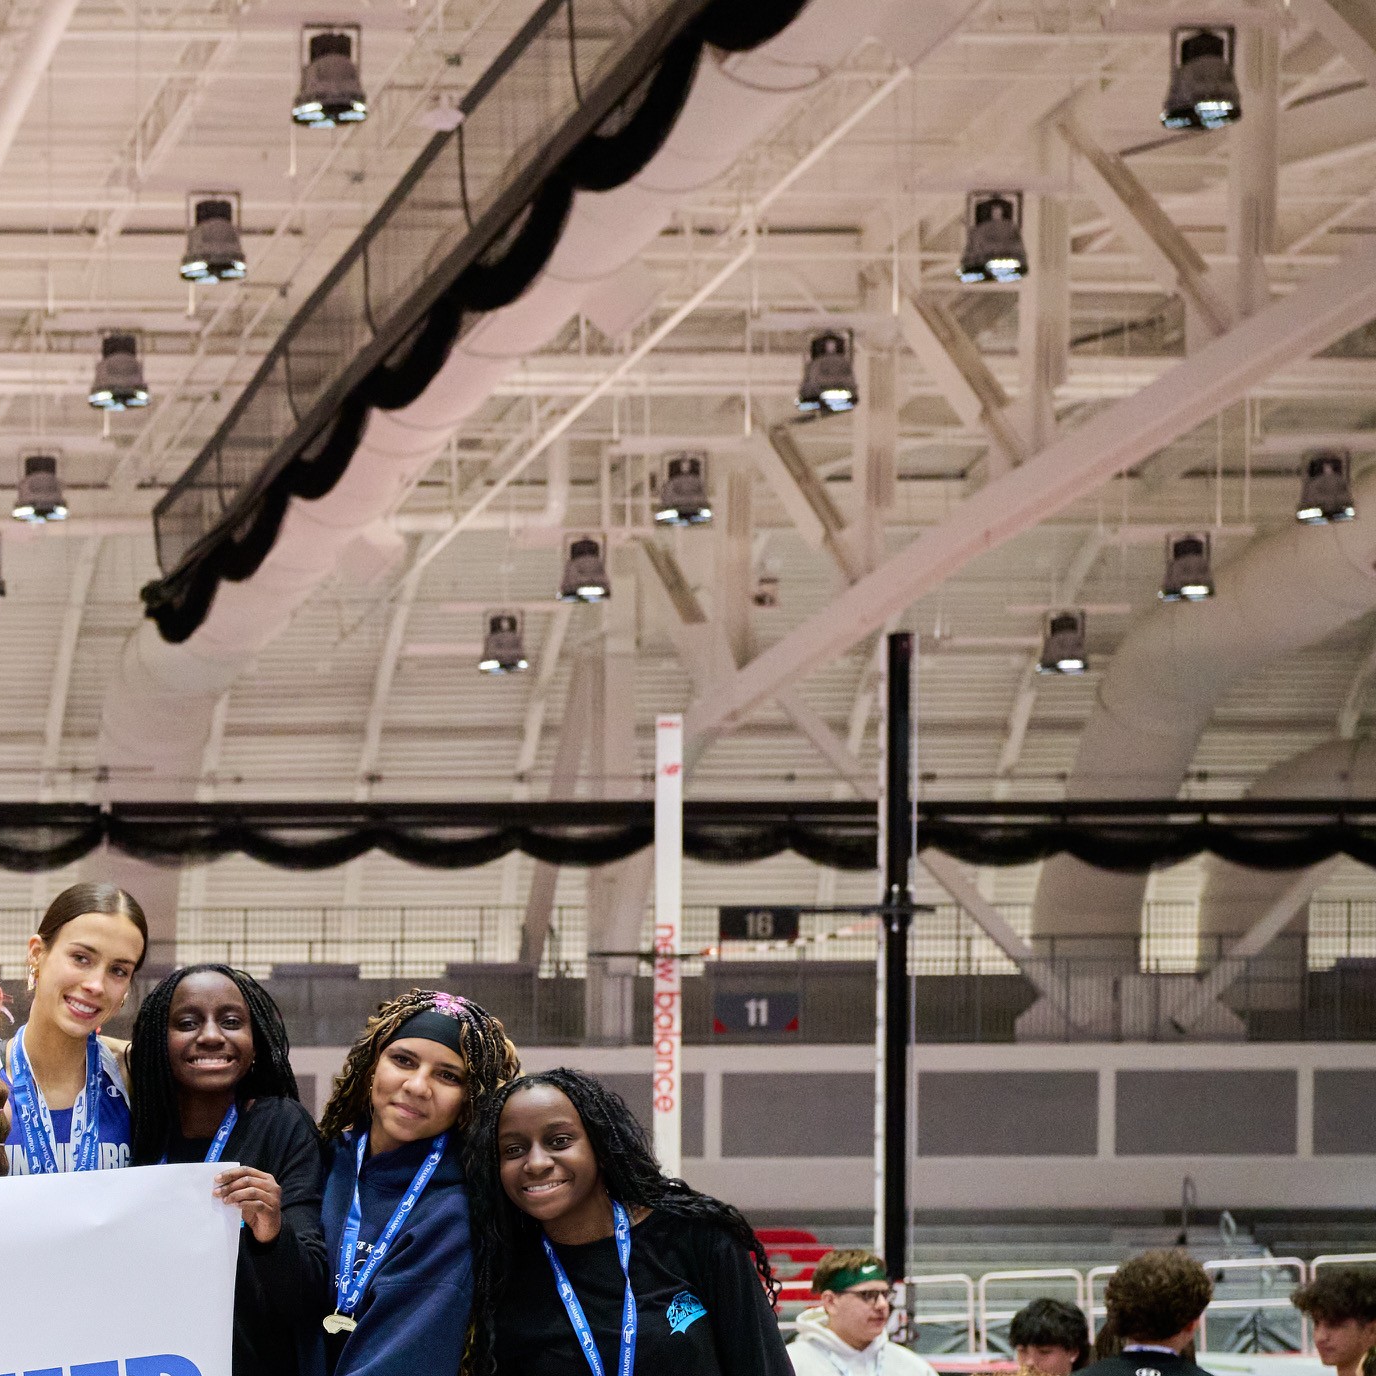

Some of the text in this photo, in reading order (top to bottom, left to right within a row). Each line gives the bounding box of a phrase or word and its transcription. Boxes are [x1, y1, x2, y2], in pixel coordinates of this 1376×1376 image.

[745, 998, 768, 1027] 11
[654, 992, 682, 1112] balance
[569, 1302, 585, 1330] CHAMPION
